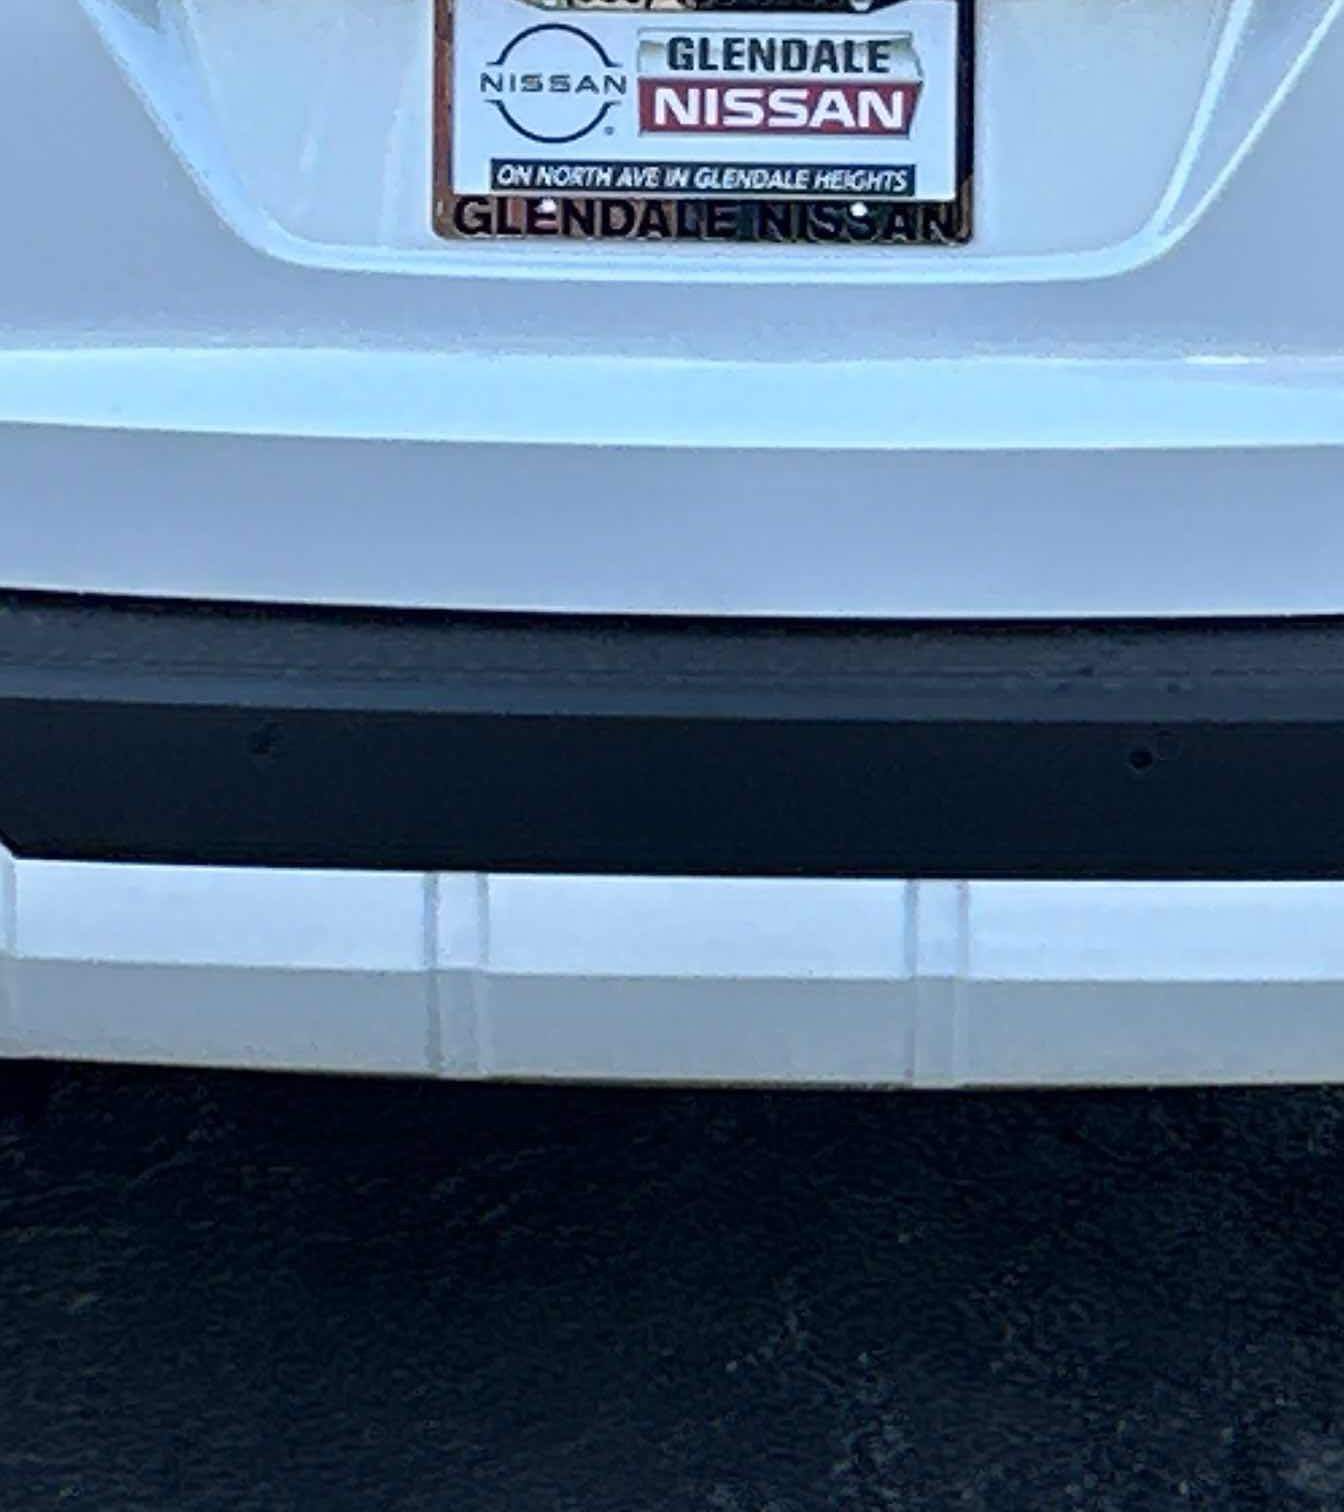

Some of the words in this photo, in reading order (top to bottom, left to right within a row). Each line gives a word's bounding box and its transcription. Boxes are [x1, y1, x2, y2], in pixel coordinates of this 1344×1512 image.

[666, 37, 891, 74] GLENDALE
[480, 72, 627, 96] NISSAN
[655, 88, 905, 129] NISSAN
[496, 164, 532, 185] ON
[536, 165, 612, 187] NORTH
[615, 166, 662, 187] AVE
[663, 167, 691, 187] IN
[693, 168, 809, 189] GLENDALE
[813, 169, 907, 192] HEIGHTS
[455, 197, 739, 237] GLENDALE
[758, 199, 959, 240] NISSAN
